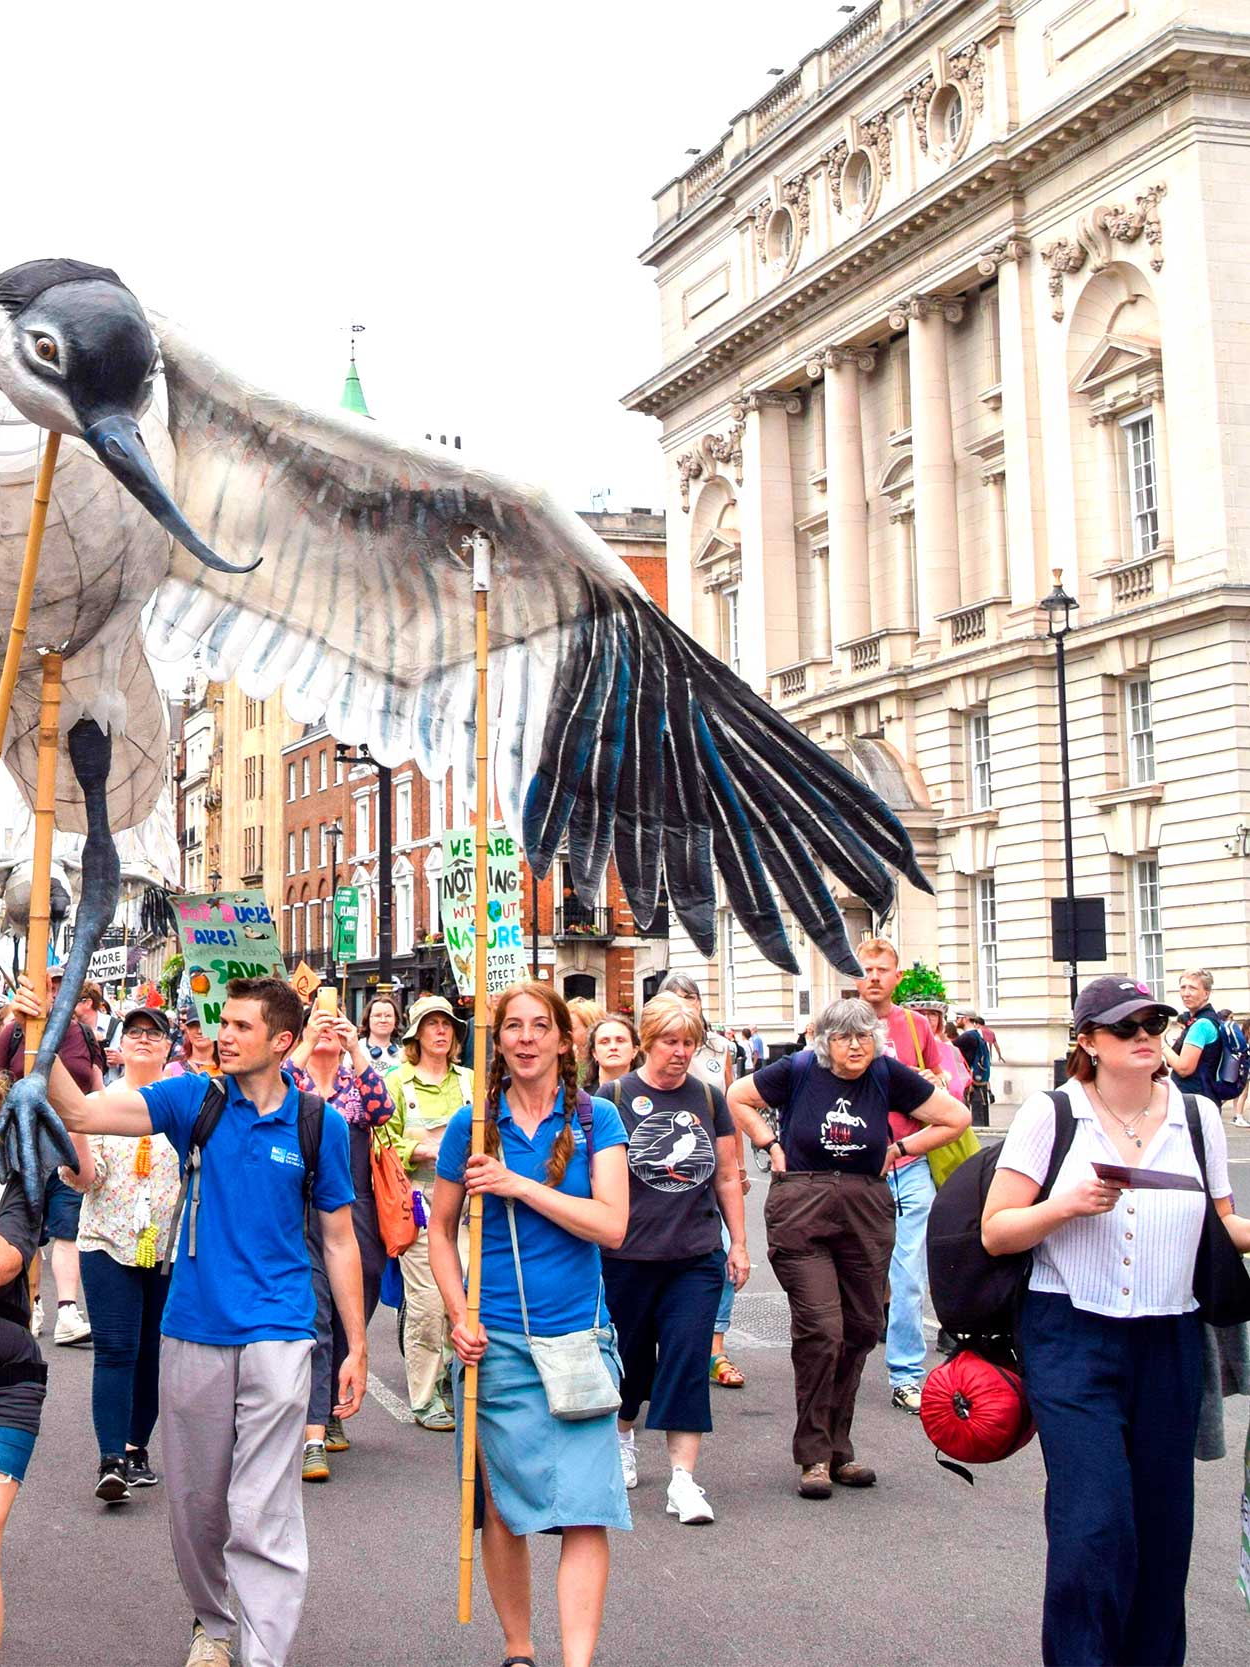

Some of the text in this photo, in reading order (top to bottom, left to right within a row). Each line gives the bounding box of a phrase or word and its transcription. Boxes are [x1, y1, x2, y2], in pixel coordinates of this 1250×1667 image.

[450, 838, 473, 857] WE
[444, 866, 518, 899] NOTING
[92, 952, 121, 966] MORE
[487, 954, 516, 967] STORE
[487, 968, 516, 981] OTECT
